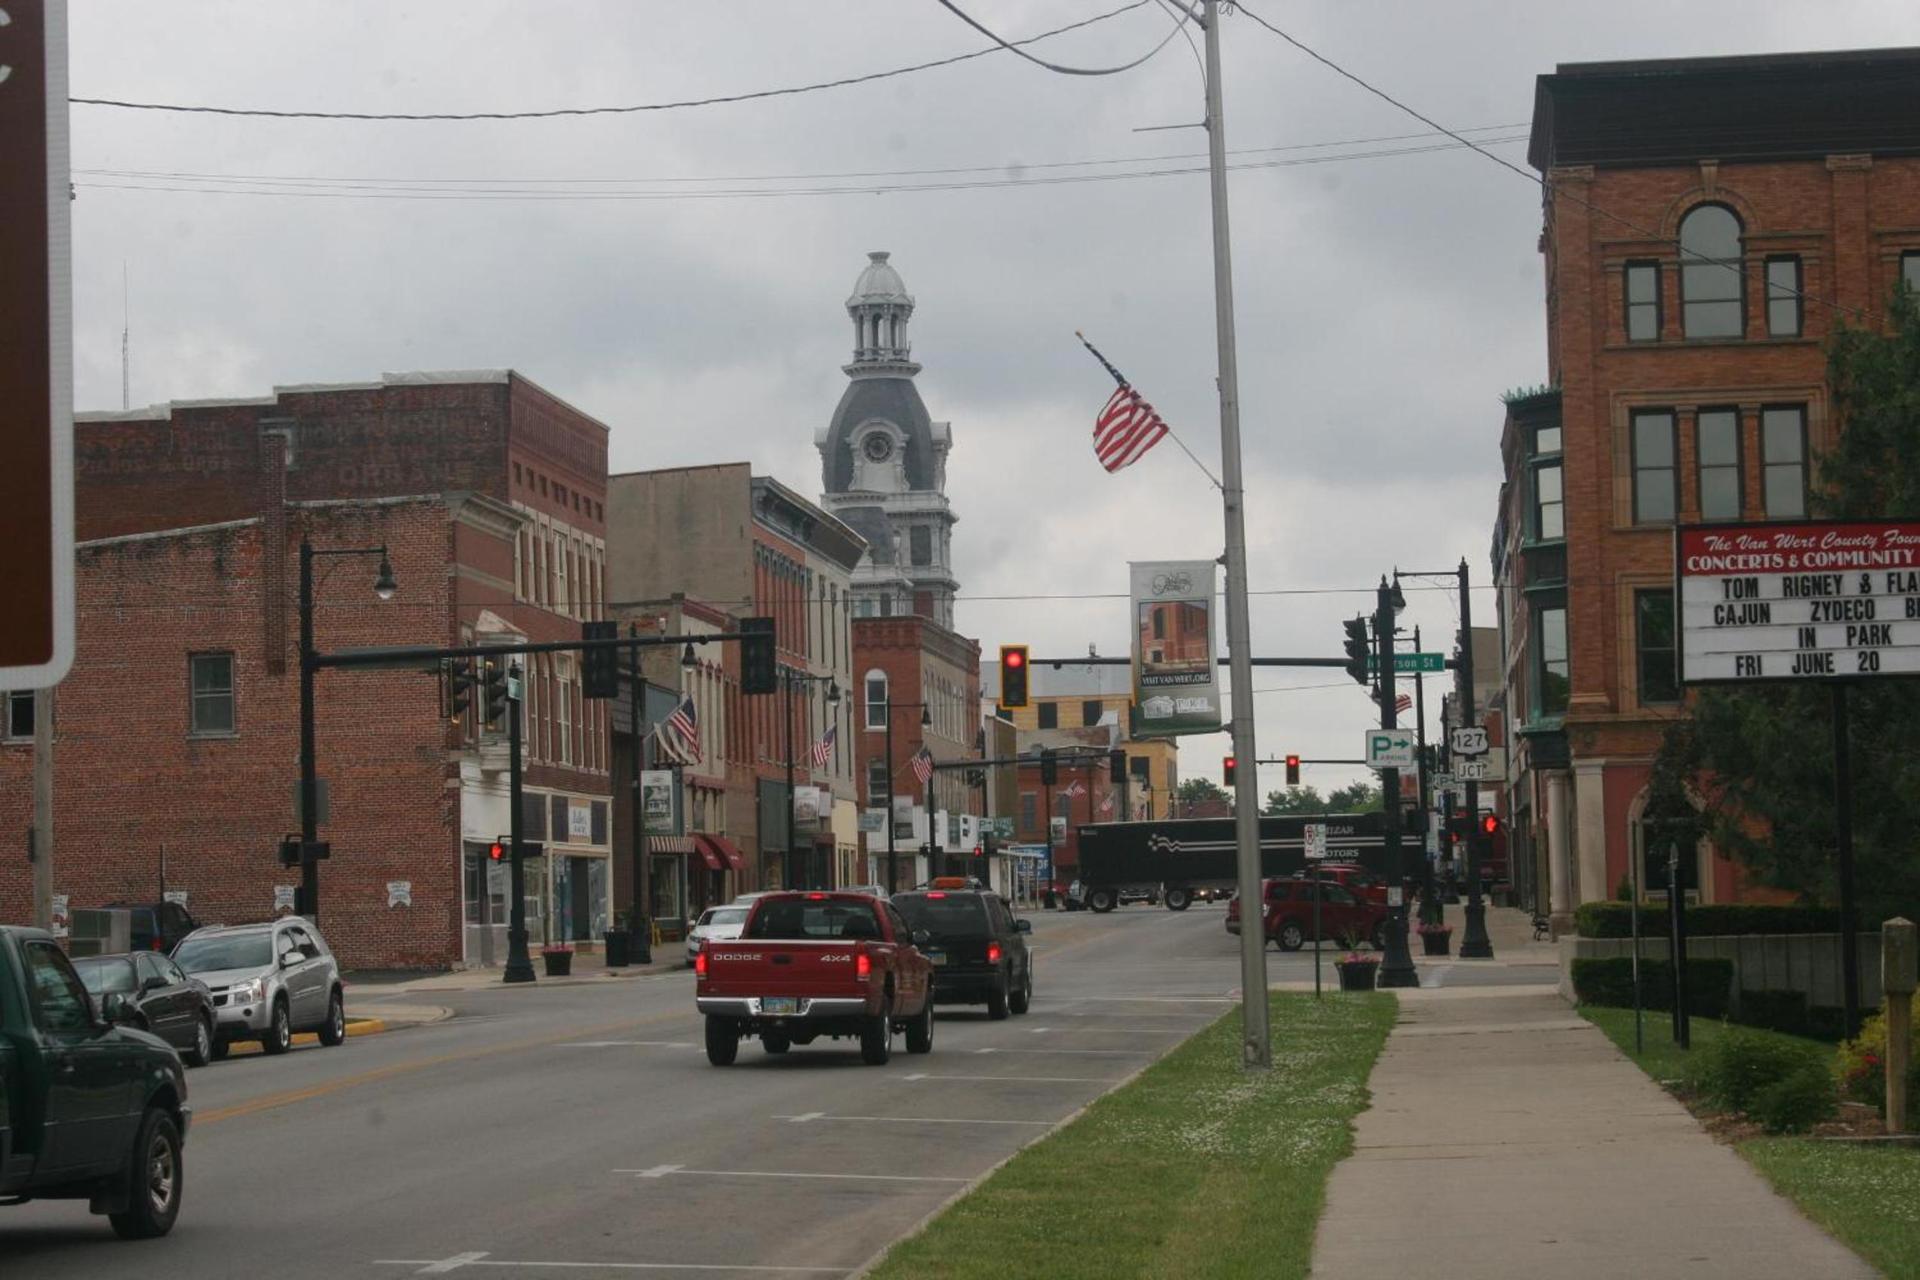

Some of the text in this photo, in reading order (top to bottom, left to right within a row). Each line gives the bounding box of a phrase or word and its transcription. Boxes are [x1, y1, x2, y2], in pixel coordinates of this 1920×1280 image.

[1704, 535, 1732, 551] The
[1736, 534, 1768, 550] Van
[1774, 533, 1816, 549] Wert
[1821, 531, 1878, 550] County
[1687, 548, 1914, 572] CONCERTS & COMMUNITY
[1722, 571, 1920, 599] TOM RIGNEY & FLA
[1714, 602, 1771, 626] CAJUN
[1810, 599, 1876, 622] ZYDECO
[1798, 624, 1893, 648] IN PARK
[1423, 657, 1434, 668] St
[1735, 651, 1880, 676] FRI JUNE 20
[1457, 733, 1483, 748] 127
[1460, 764, 1482, 777] JCT
[1324, 848, 1359, 858] OTORS
[713, 953, 762, 961] DODGE
